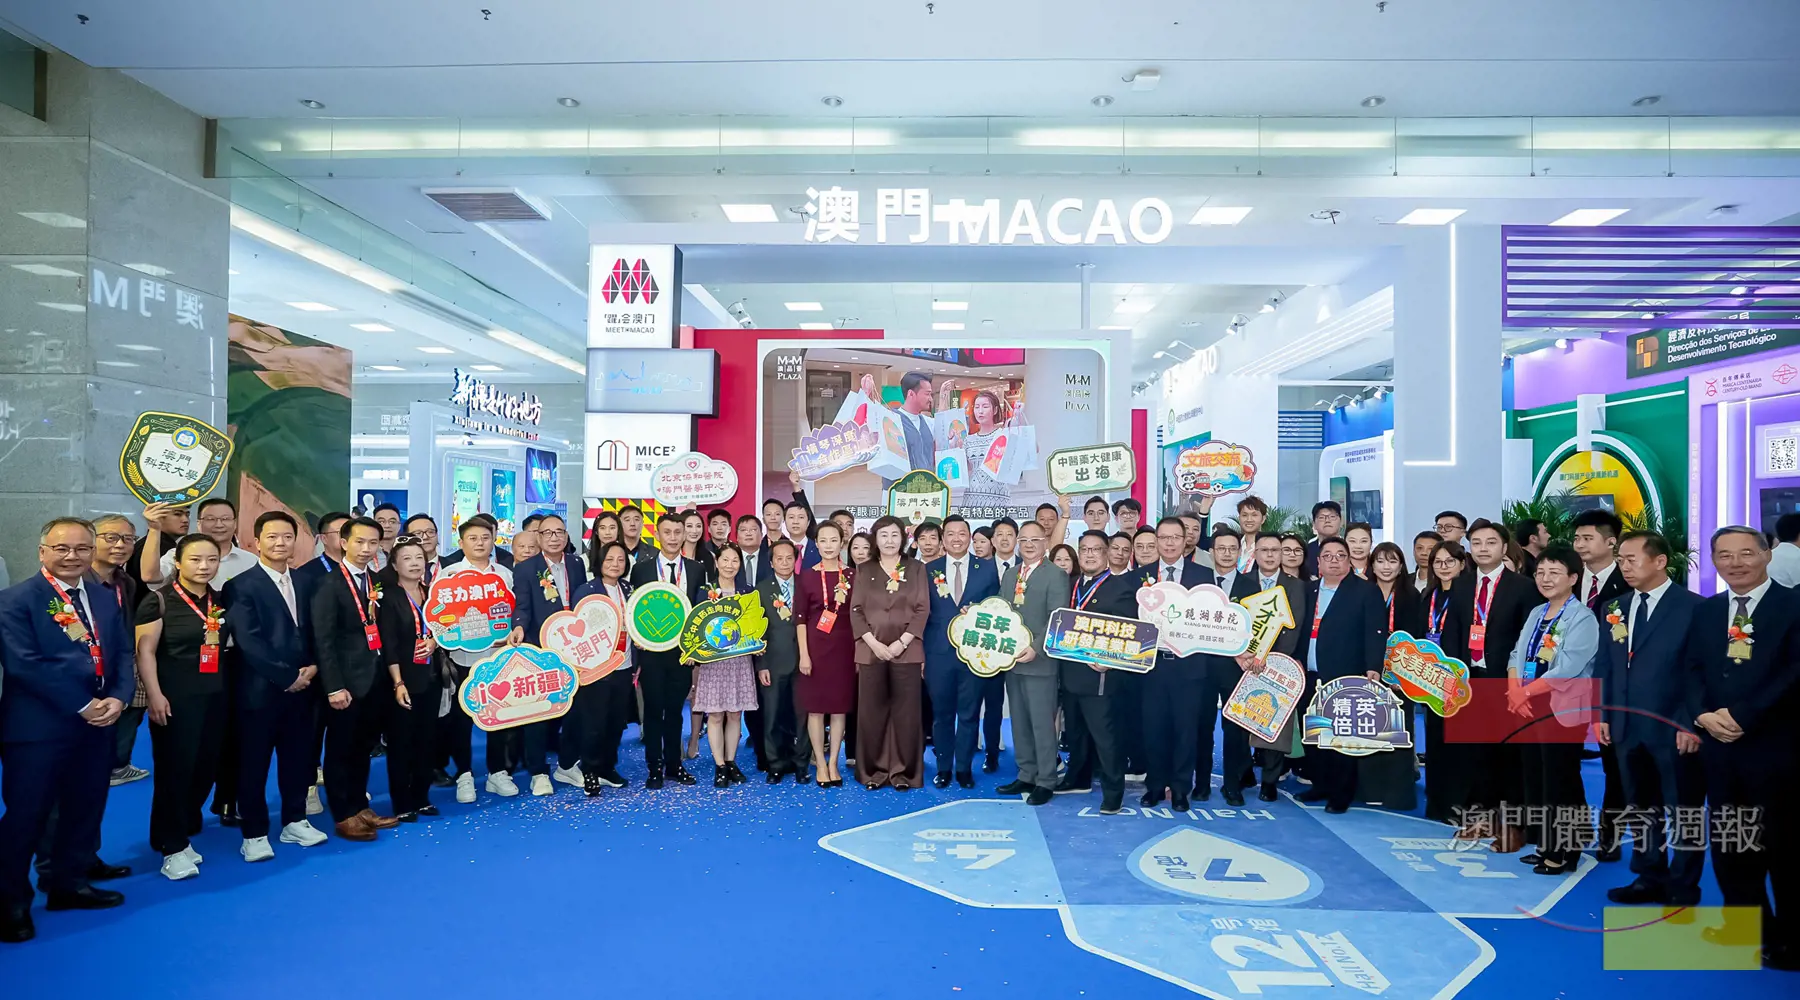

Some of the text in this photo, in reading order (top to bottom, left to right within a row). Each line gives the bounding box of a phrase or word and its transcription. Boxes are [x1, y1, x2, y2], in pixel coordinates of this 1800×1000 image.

[804, 186, 1173, 244] 澳門 MACAO
[1668, 341, 1698, 354] Direcção
[1699, 338, 1712, 349] dos
[1714, 330, 1747, 345] Serviços
[1668, 333, 1777, 363] Desenvolvimento Tecnológico
[162, 448, 193, 466] 澳門
[1057, 450, 1122, 468] 中醫藥大健康
[1183, 452, 1241, 468] 文旅交流
[144, 456, 199, 481] 科技大學
[661, 471, 724, 482] 北京協和醫院
[1075, 465, 1110, 482] 出海
[662, 482, 724, 494] 澳門醫學中心
[896, 497, 941, 508] 澳門大學
[437, 583, 498, 604] 活力澳門
[975, 611, 1012, 634] 百年
[1073, 615, 1137, 640] 澳門科技
[1185, 608, 1239, 626] 鏡湖醫院
[1212, 624, 1238, 632] HOSPITAL
[557, 626, 613, 665] I 澳門
[962, 629, 1018, 656] 傳承店
[1392, 648, 1457, 694] 大美新疆
[479, 669, 561, 704] i 新疆
[1332, 698, 1377, 716] 精英
[1333, 717, 1377, 736] 倍出
[1187, 807, 1277, 821] Hall
[946, 844, 1016, 869] 4
[1204, 858, 1267, 883] 7
[1211, 934, 1334, 994] 12
